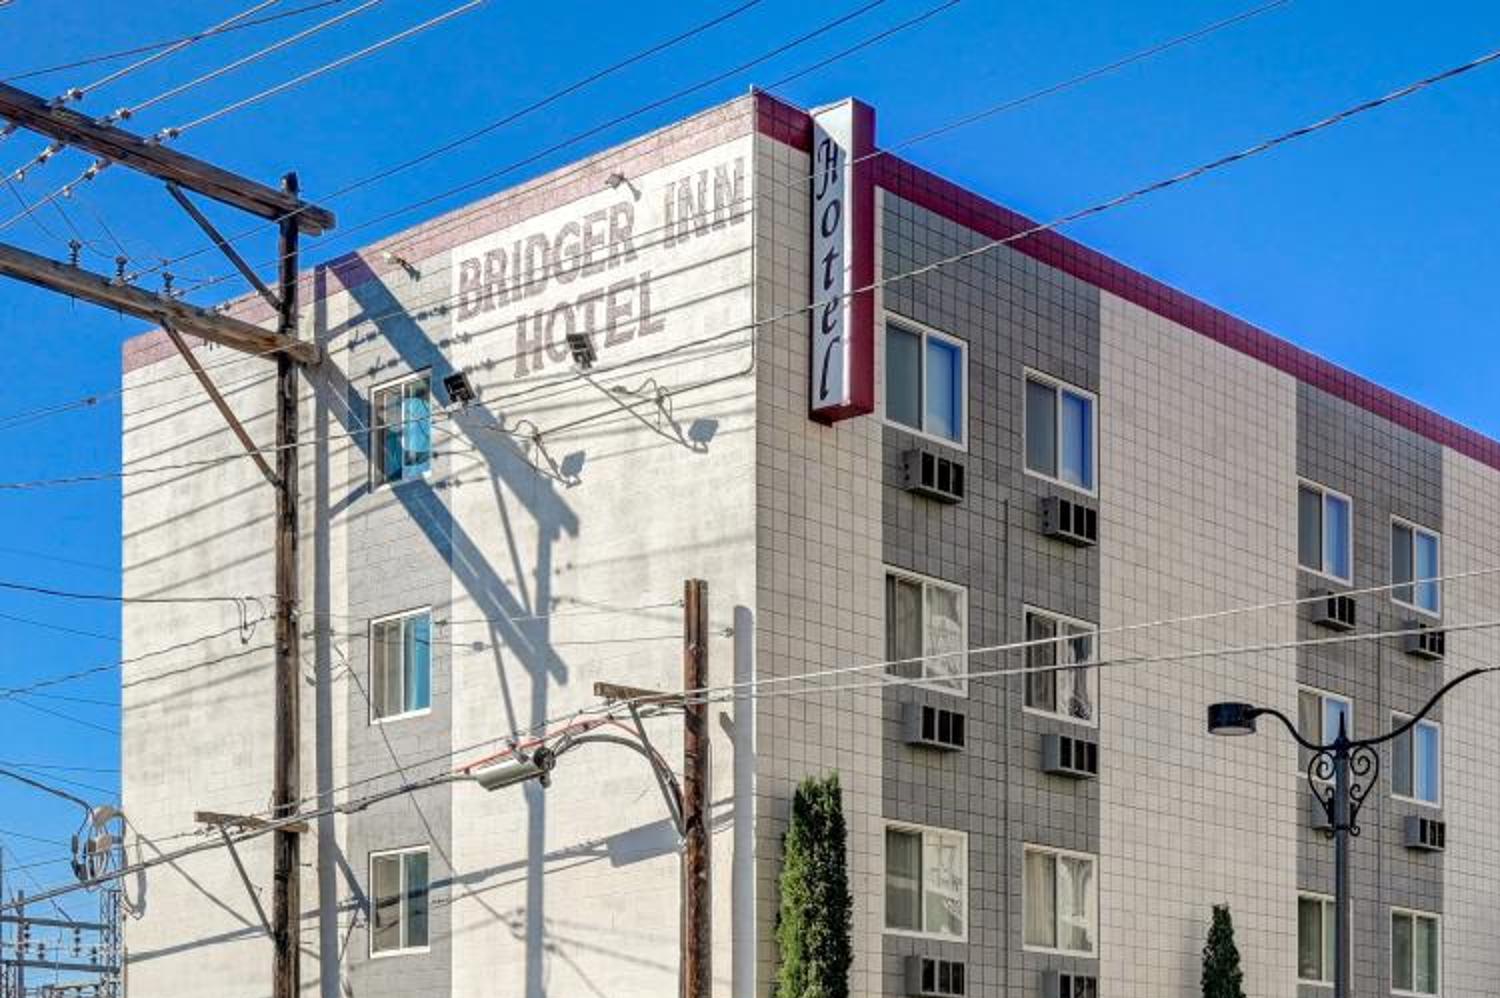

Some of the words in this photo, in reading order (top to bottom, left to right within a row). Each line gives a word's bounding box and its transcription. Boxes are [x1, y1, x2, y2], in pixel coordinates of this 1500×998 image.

[456, 201, 638, 322] BRIDGER
[662, 156, 746, 249] INN
[815, 138, 841, 401] Hotel
[513, 269, 666, 378] HOTEL
